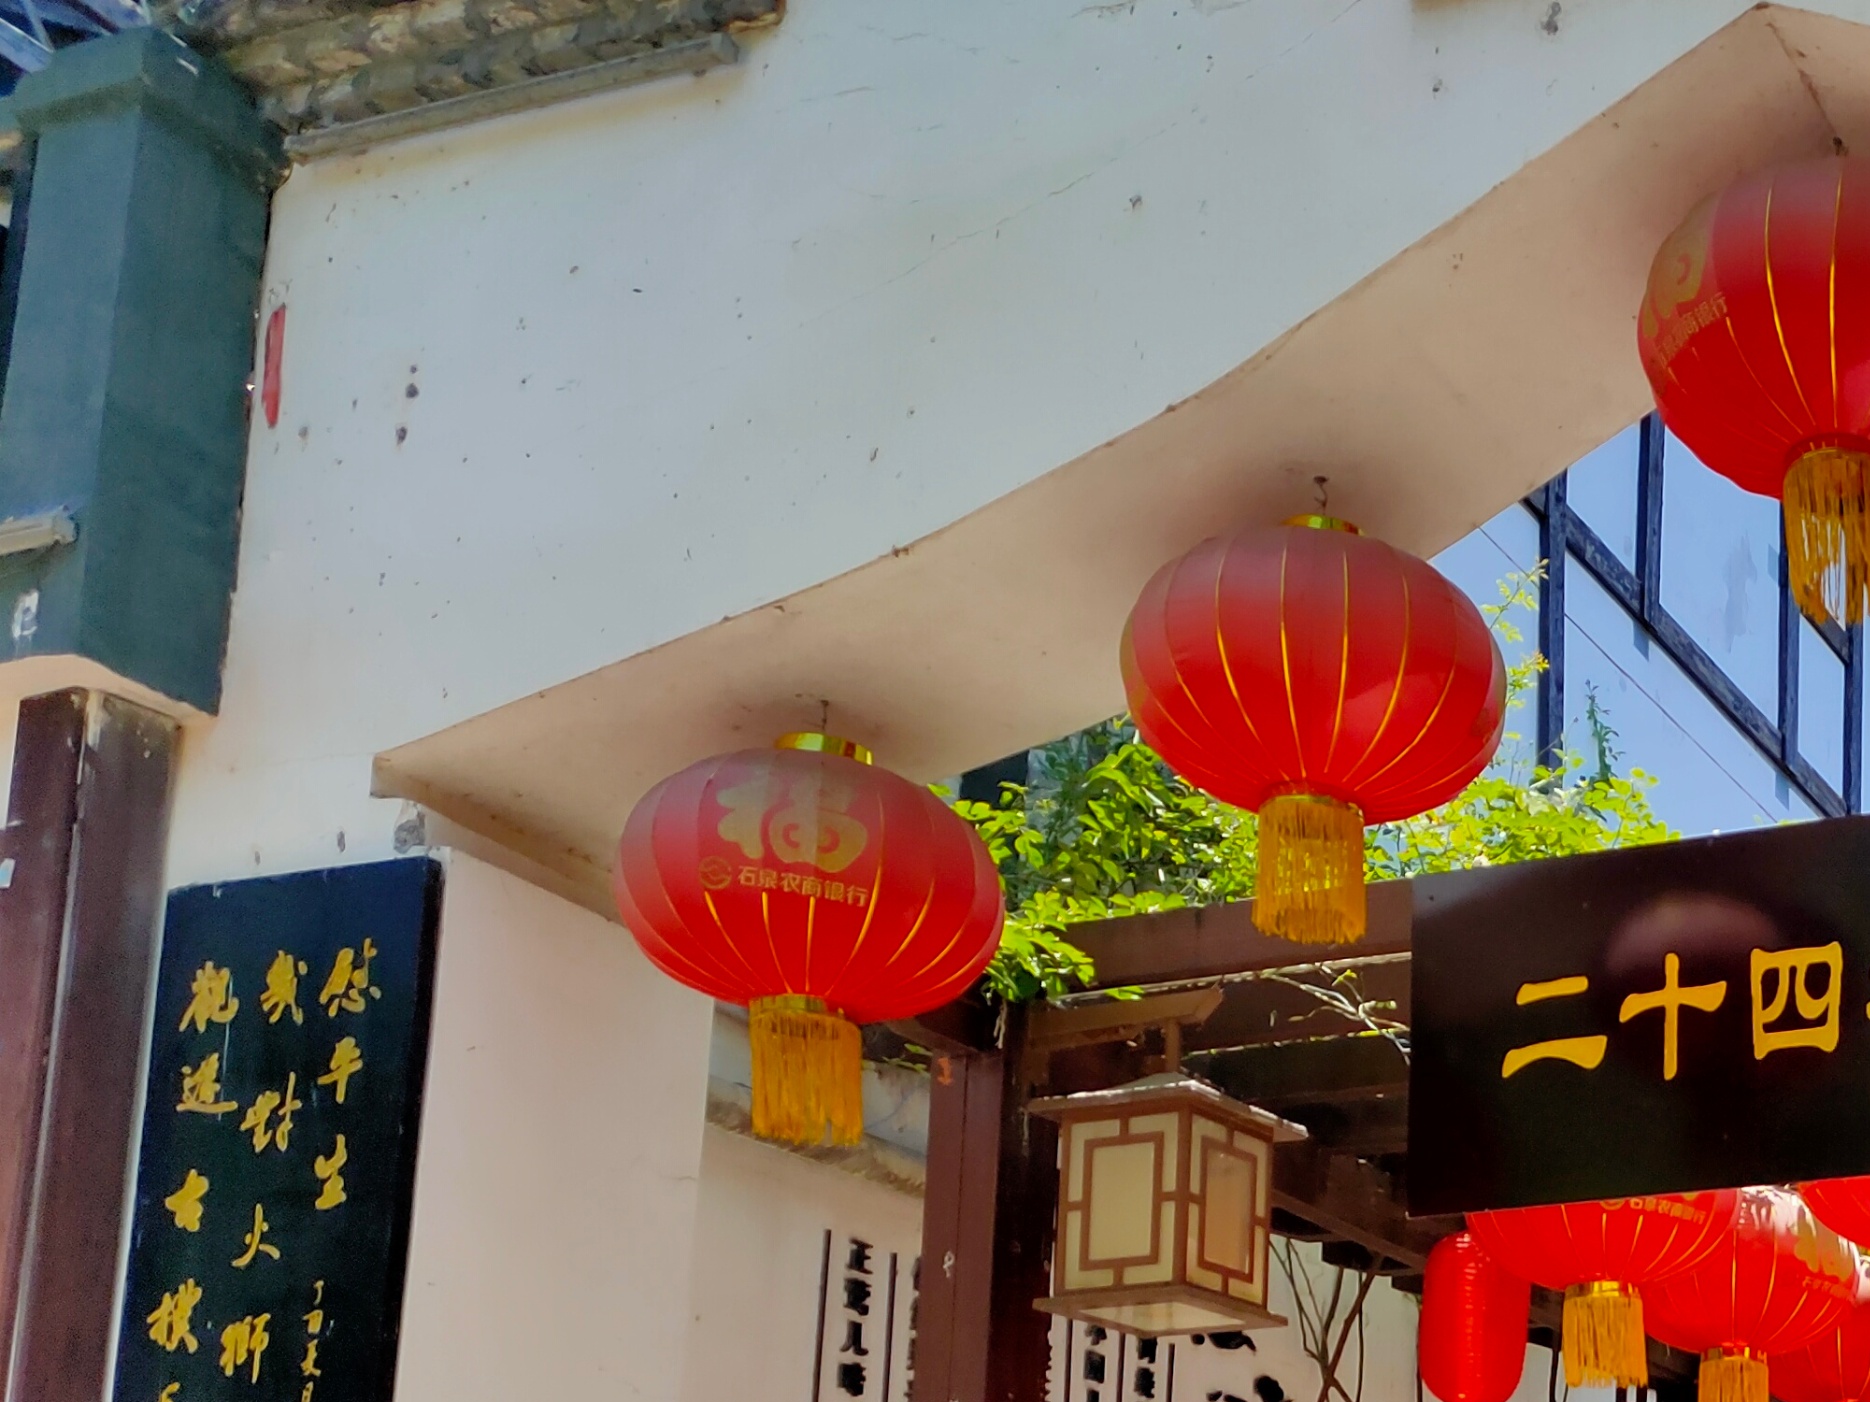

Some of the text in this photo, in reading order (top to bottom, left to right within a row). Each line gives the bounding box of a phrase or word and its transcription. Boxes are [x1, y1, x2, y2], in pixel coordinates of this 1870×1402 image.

[738, 865, 868, 907] 石泉农商银行
